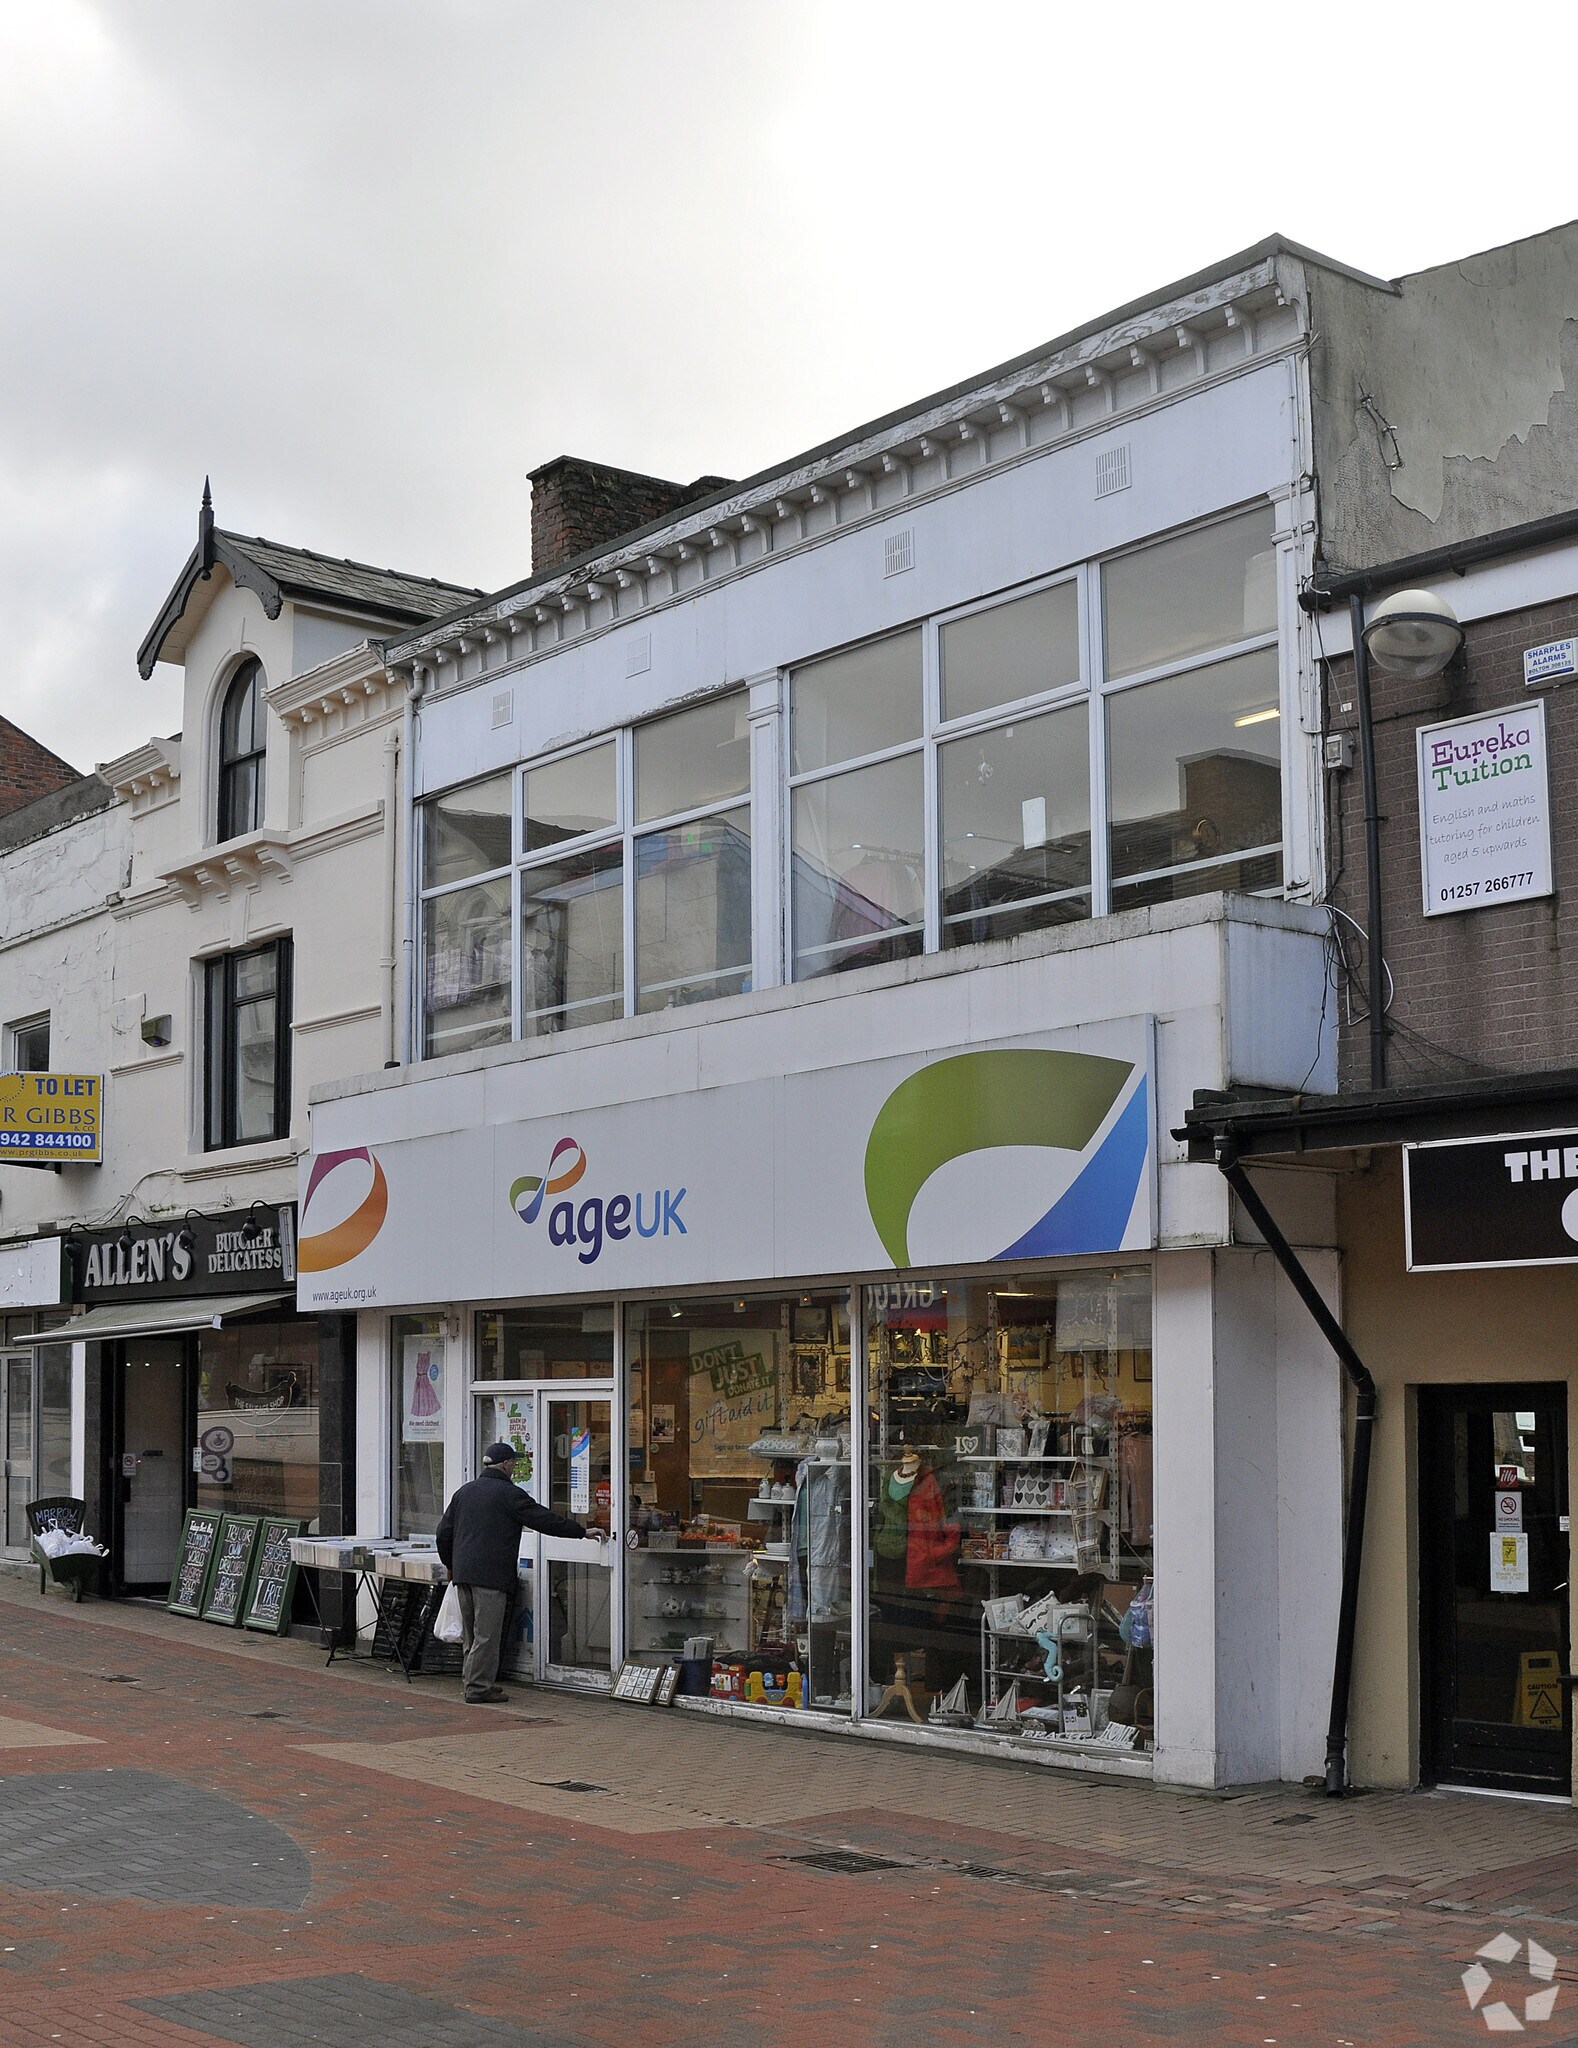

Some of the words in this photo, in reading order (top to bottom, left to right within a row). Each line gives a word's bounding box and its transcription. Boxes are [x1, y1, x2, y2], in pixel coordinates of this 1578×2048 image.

[1527, 643, 1571, 659] SHARPLES
[1533, 652, 1567, 667] ALARMS
[1528, 665, 1550, 674] BOLTON
[1431, 722, 1531, 767] Eureka
[1432, 753, 1533, 791] Tuition
[1432, 808, 1475, 825] English
[1477, 801, 1499, 815] and
[1501, 794, 1536, 809] maths
[1429, 829, 1475, 845] tutoring
[1477, 823, 1493, 839] for
[1495, 815, 1541, 832] children
[1443, 848, 1469, 865] aged
[1471, 847, 1480, 857] 5
[1482, 837, 1528, 858] upwards
[1440, 882, 1481, 901] 01257
[1484, 871, 1534, 893] 266777
[35, 1078, 58, 1096] TO
[64, 1078, 96, 1096] LET
[3, 1106, 18, 1123] R
[26, 1107, 96, 1125] GIBBS
[0, 1132, 31, 1146] 942
[35, 1133, 92, 1147] 844100
[84, 1230, 192, 1288] ALLEN'S
[312, 1285, 377, 1304] www.ageuk.org.uk
[691, 1344, 738, 1372] DON'T
[715, 1356, 758, 1389] JUST
[727, 1378, 761, 1396] DONATE
[760, 1375, 771, 1386] IT
[757, 1392, 775, 1413] it
[1500, 1470, 1517, 1486] illy
[35, 1507, 78, 1524] MARROW
[227, 1524, 240, 1541] TRY
[238, 1527, 253, 1543] OUR
[276, 1528, 288, 1546] 2
[228, 1542, 243, 1556] OWN
[219, 1576, 236, 1592] BACK
[262, 1580, 283, 1607] FREE
[213, 1591, 237, 1608] BACON
